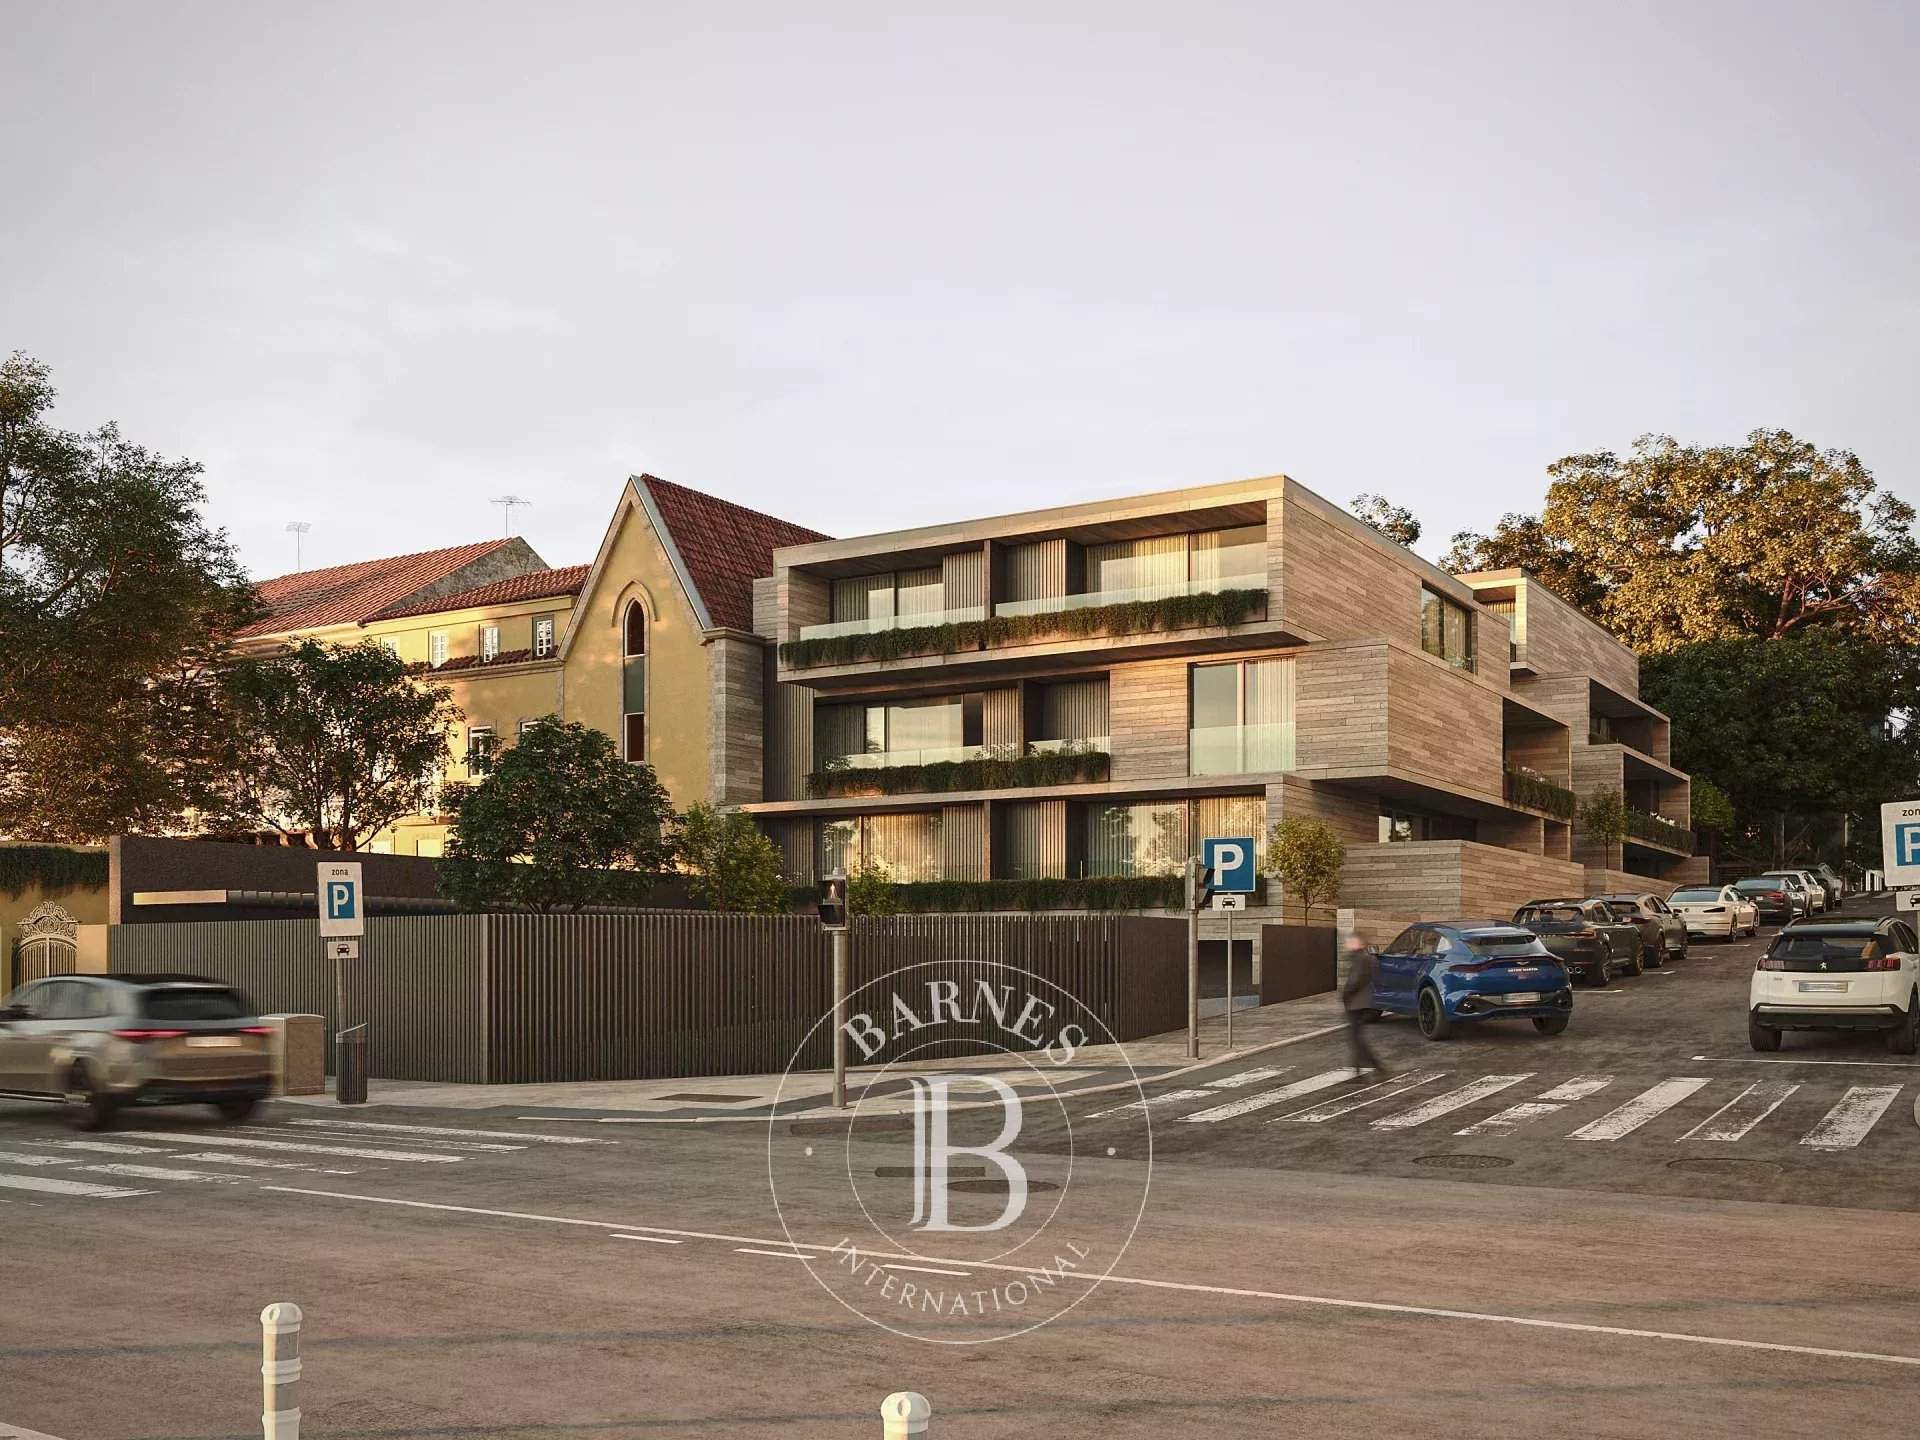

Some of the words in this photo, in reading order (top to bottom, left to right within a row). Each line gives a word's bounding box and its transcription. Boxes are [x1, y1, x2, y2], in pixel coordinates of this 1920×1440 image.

[331, 868, 349, 876] zona
[1214, 844, 1243, 885] P
[333, 884, 349, 916] P
